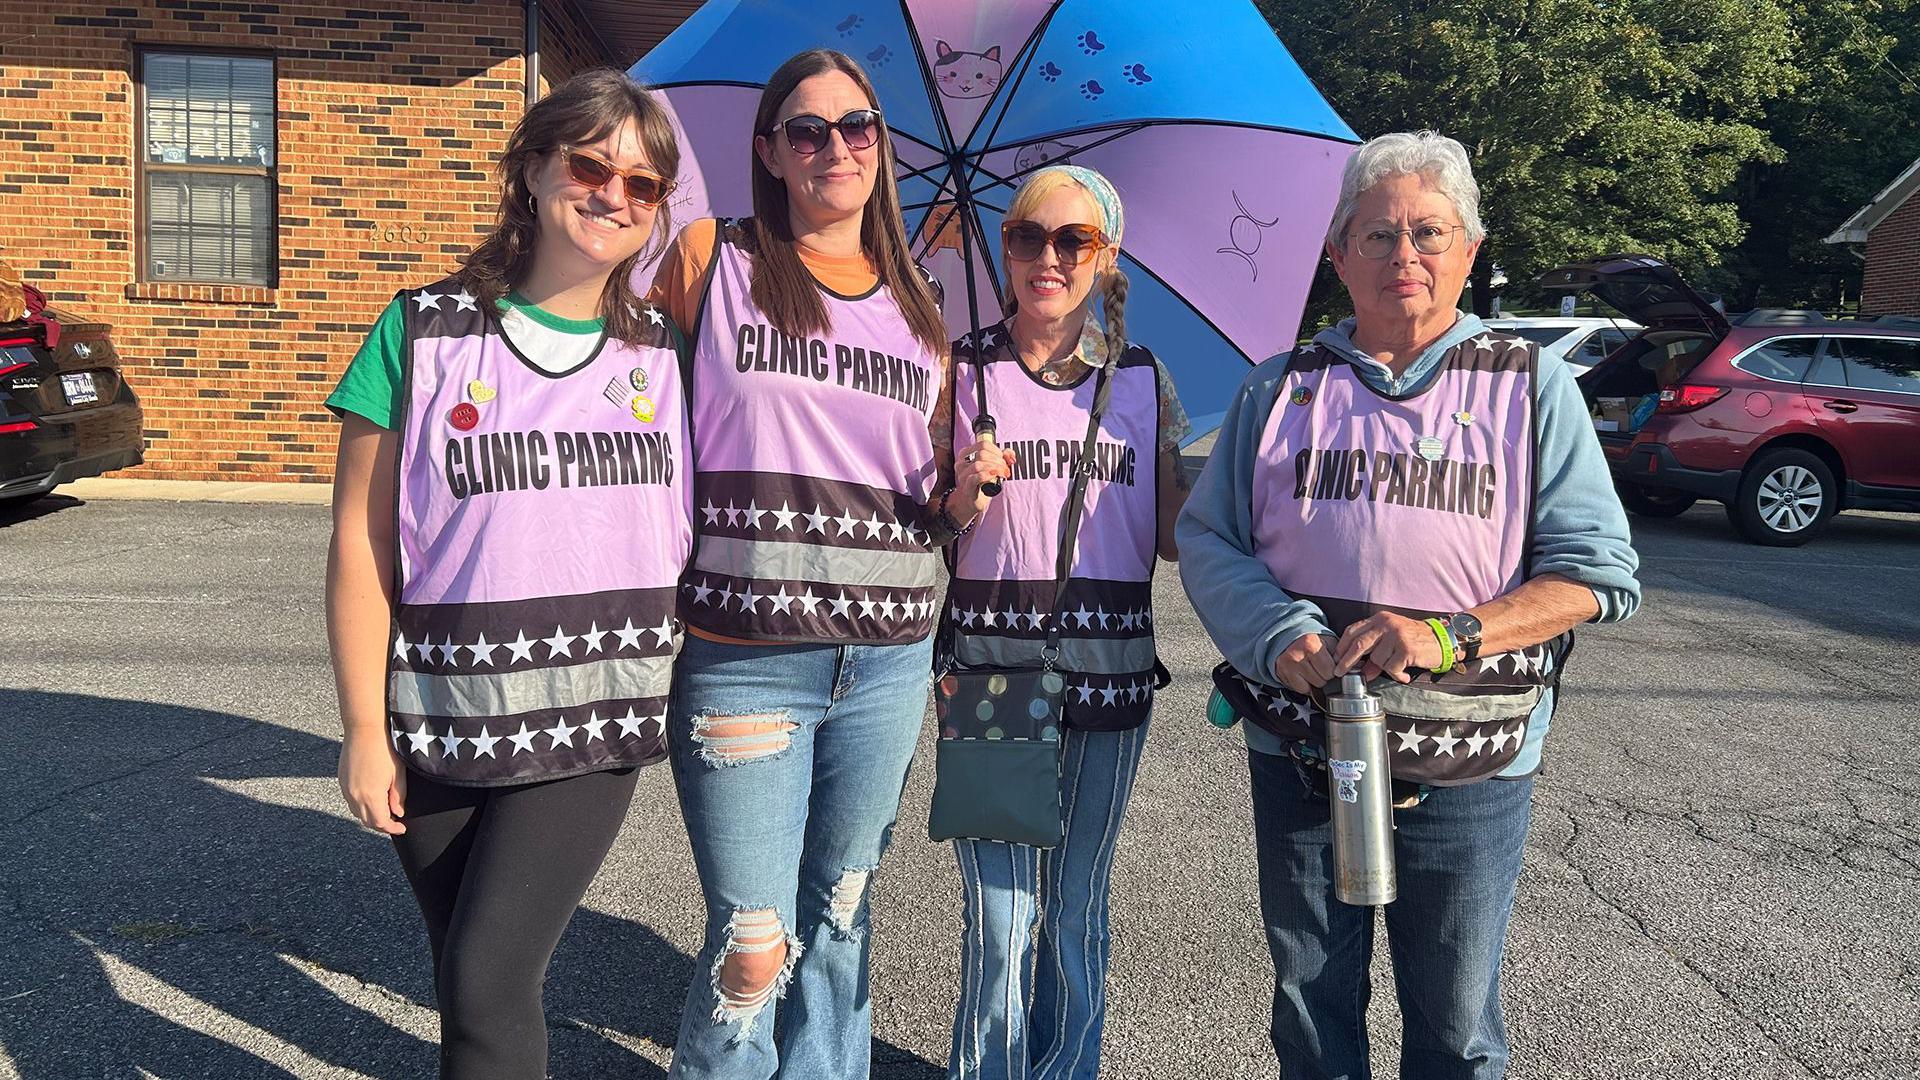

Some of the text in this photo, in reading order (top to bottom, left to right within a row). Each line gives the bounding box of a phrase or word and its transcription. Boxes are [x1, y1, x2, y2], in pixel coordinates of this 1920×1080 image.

[735, 323, 931, 412] CLINIC PARKING
[445, 430, 674, 500] CLINIC PARKING
[996, 439, 1136, 487] NIC PAKING
[1368, 451, 1496, 519] PARKING
